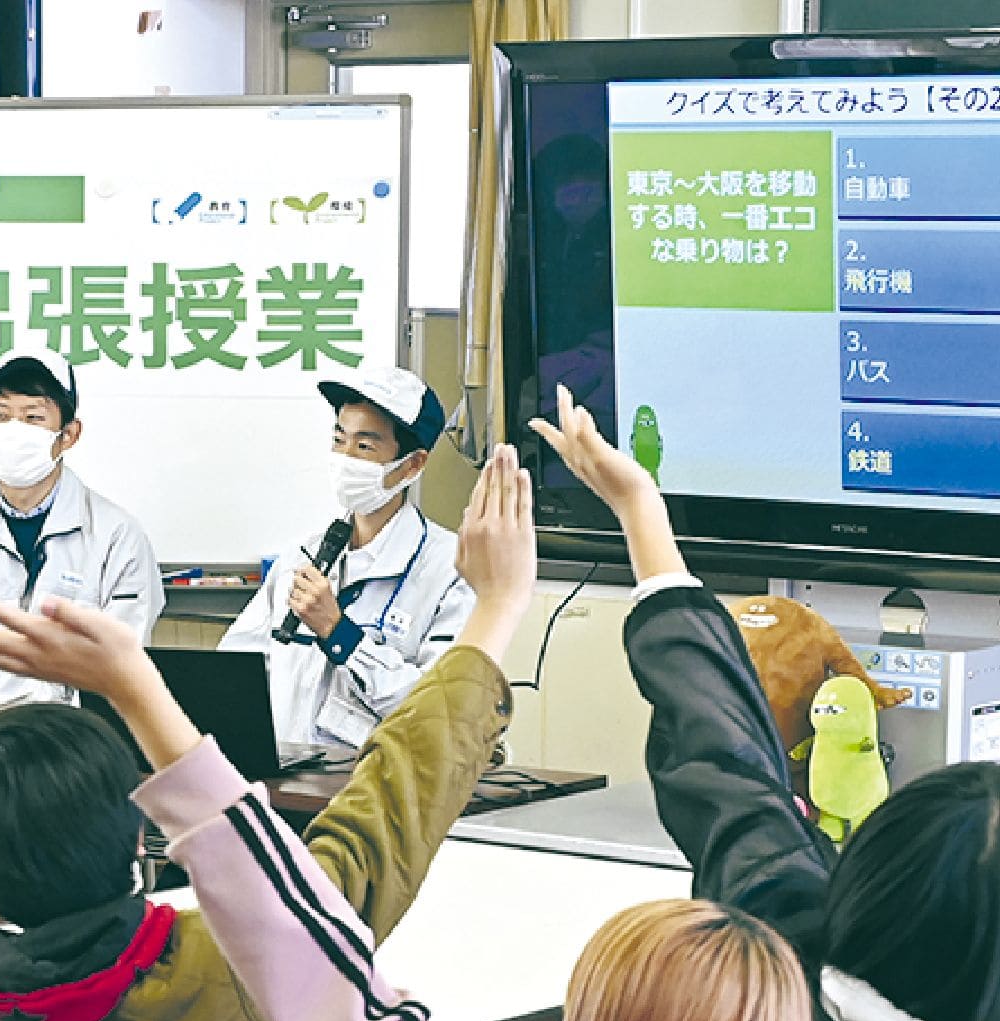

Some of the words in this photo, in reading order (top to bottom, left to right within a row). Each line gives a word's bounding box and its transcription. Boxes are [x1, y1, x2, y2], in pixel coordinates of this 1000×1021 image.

[846, 148, 866, 168] 1.
[845, 176, 910, 201] 自動車
[627, 203, 816, 231] する時、一番エコ
[651, 237, 789, 264] な乗り物は？
[846, 239, 867, 261] 2.
[844, 268, 914, 294] 飛行機
[847, 330, 868, 352] 3.
[846, 359, 890, 383] バス
[847, 420, 871, 442] 4.
[848, 449, 893, 475] 鉄道
